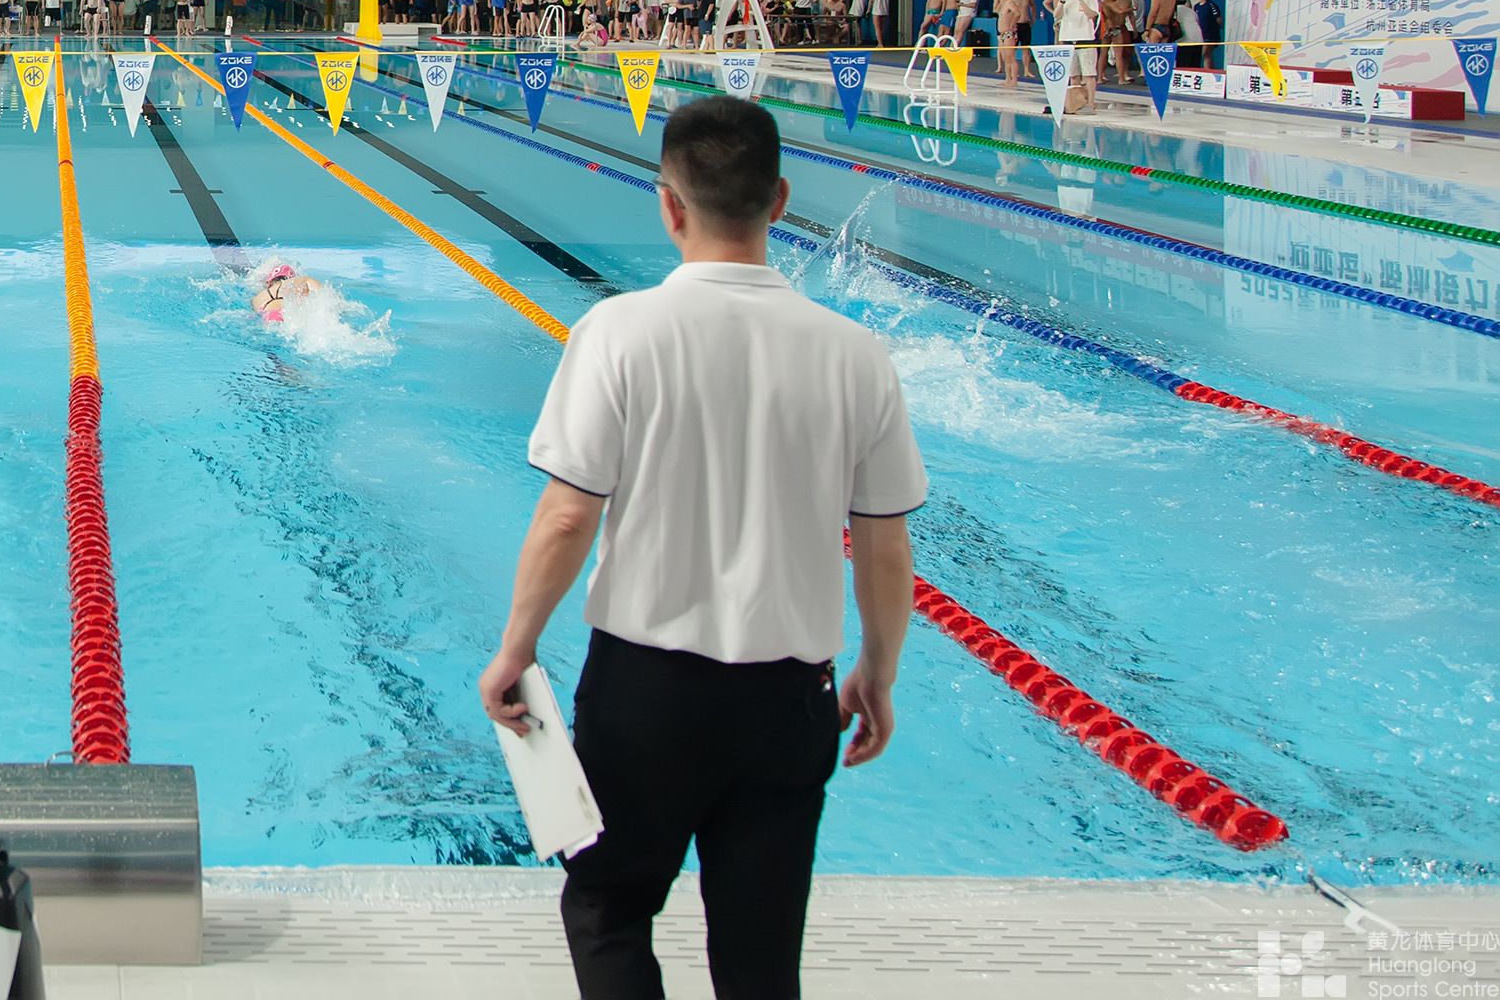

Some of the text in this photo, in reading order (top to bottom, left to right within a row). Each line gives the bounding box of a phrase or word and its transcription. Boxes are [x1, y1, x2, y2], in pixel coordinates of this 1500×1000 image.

[1139, 45, 1174, 54] ZOKE
[1350, 47, 1384, 56] ZOKE
[1459, 43, 1493, 52] ZOKE
[1037, 50, 1070, 58] ZOKE
[18, 56, 50, 64] ZOKE
[220, 56, 252, 65] ZOKE
[421, 55, 452, 63] ZOKE
[520, 58, 552, 66] ZOKE
[623, 58, 654, 66] ZOKE
[723, 58, 755, 66] ZOKE
[833, 56, 866, 65] ZOKE
[118, 60, 150, 68] ZOKE
[321, 60, 352, 68] ZOKE
[1172, 73, 1202, 91] 第二名
